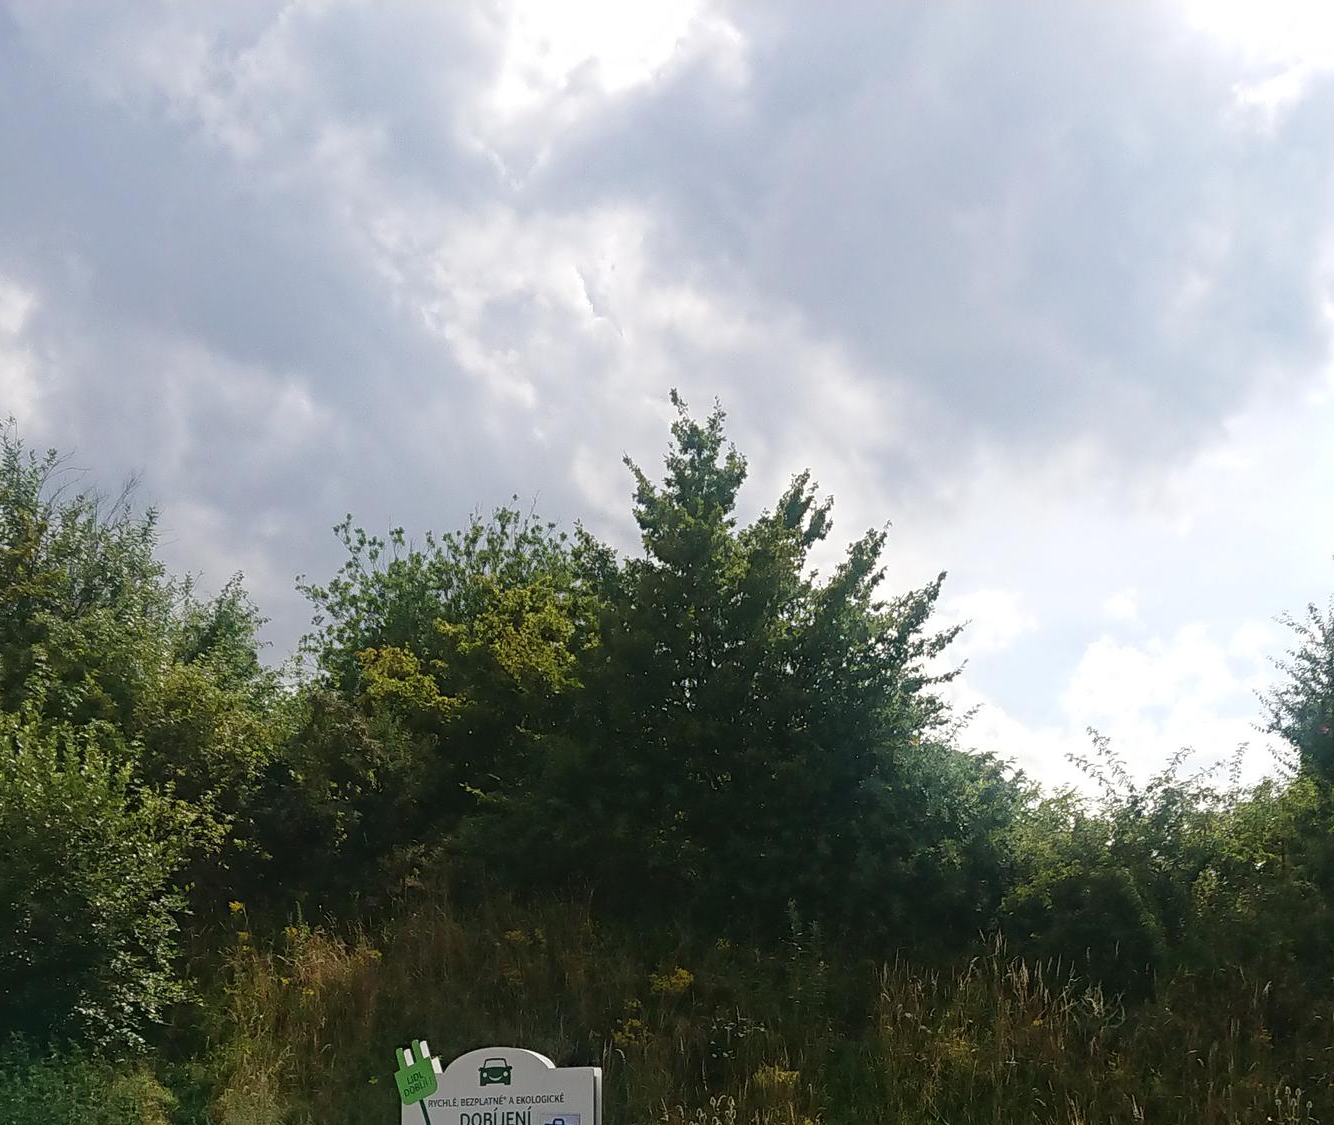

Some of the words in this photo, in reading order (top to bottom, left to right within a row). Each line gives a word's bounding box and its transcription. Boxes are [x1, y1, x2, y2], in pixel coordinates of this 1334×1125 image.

[406, 1071, 424, 1085] LIDL
[508, 1096, 515, 1105] A
[516, 1091, 565, 1105] EKOLOGICKÉ
